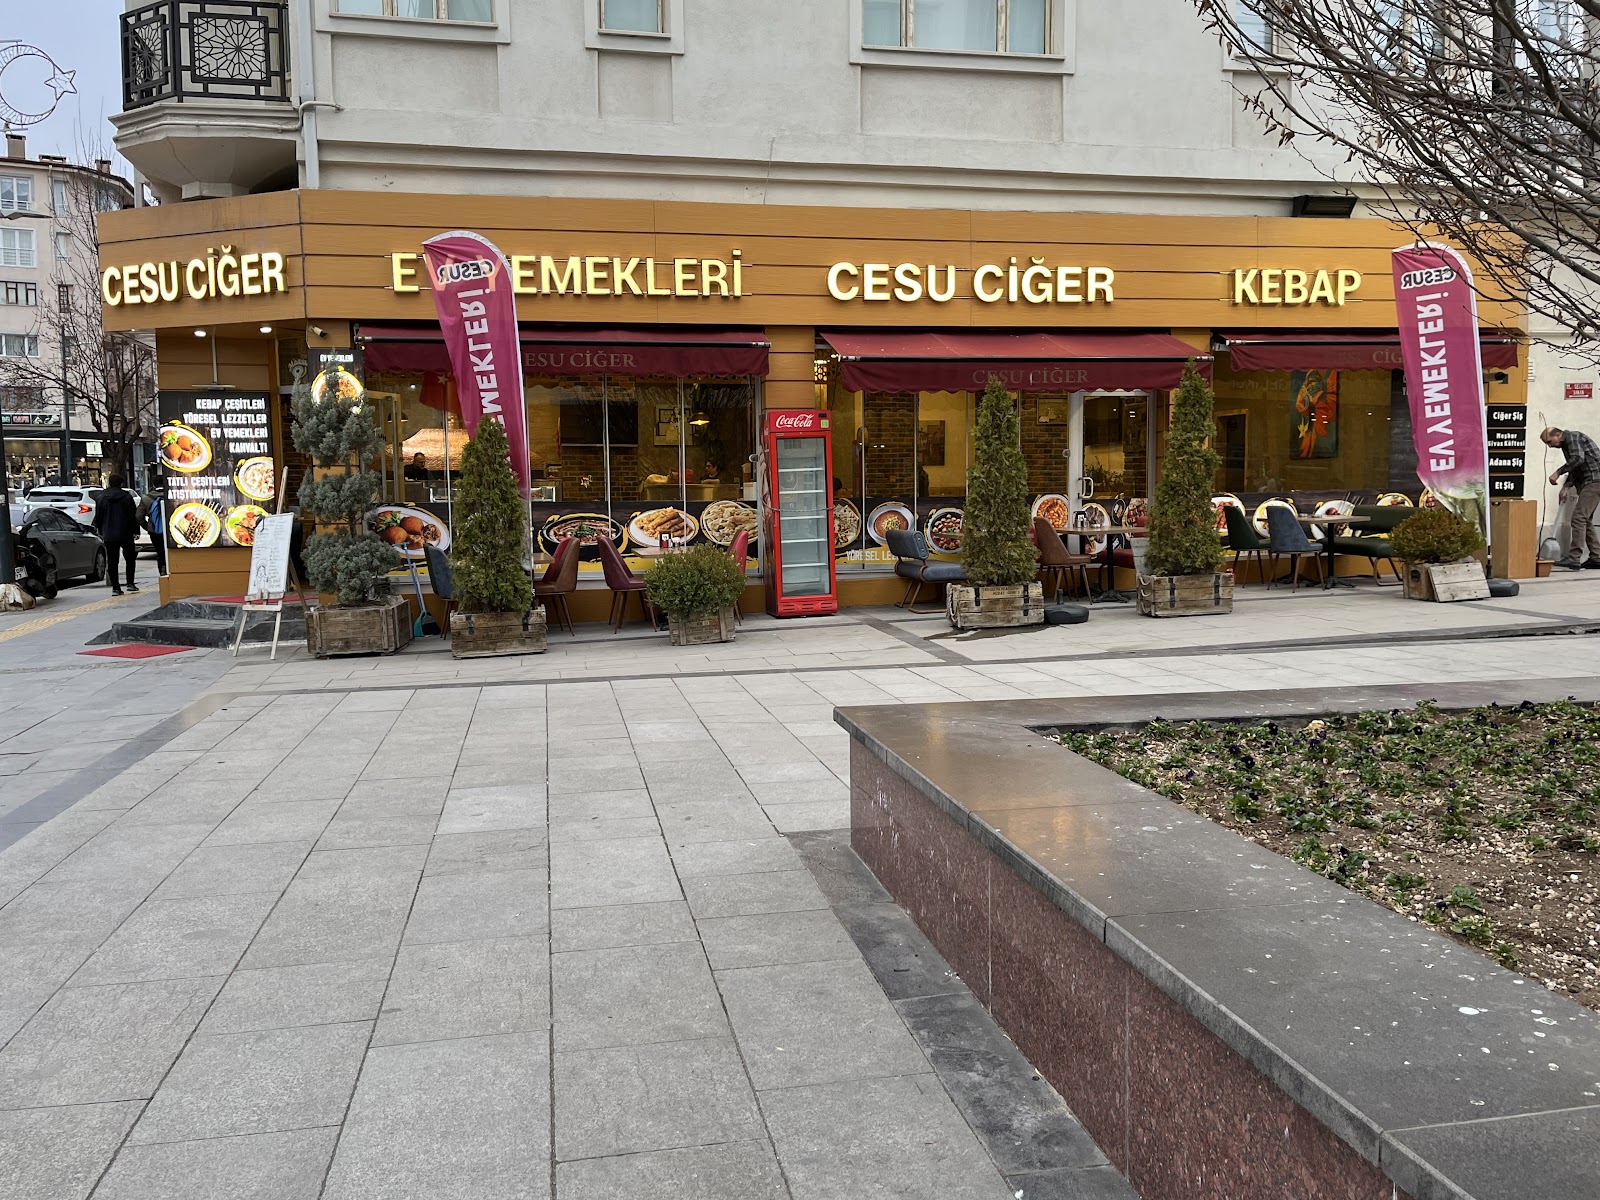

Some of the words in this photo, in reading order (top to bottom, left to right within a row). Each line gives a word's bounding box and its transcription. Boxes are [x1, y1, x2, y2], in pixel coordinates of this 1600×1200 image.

[102, 260, 180, 306] CESU
[186, 245, 286, 300] CİĞER
[476, 248, 743, 297] YEMEKLERİ
[826, 262, 957, 302] CESU
[973, 256, 1115, 304] CİĞER
[1233, 268, 1363, 305] KEBAP
[524, 352, 566, 367] ESU
[569, 350, 638, 368] CİĞER
[1028, 367, 1089, 384] CİĞER
[195, 399, 222, 410] KEBAP
[224, 397, 265, 411] ÇEŞİTLERİ
[183, 412, 219, 424] YÖRESEL
[221, 413, 267, 424] LEZZETLER
[775, 413, 814, 428] Coca-Cola
[1493, 411, 1512, 421] Ciğer
[1512, 411, 1523, 421] Şiş
[210, 428, 221, 438] EV
[223, 427, 268, 438] YEMEKLERİ
[228, 442, 268, 453] KAHVALTI
[1489, 457, 1511, 466] Adana
[1512, 458, 1523, 467] Şiş
[167, 477, 188, 487] TATLI
[1495, 481, 1503, 490] Et
[1503, 481, 1515, 490] Şiş
[168, 488, 222, 500] ATIŞTIRMALIK
